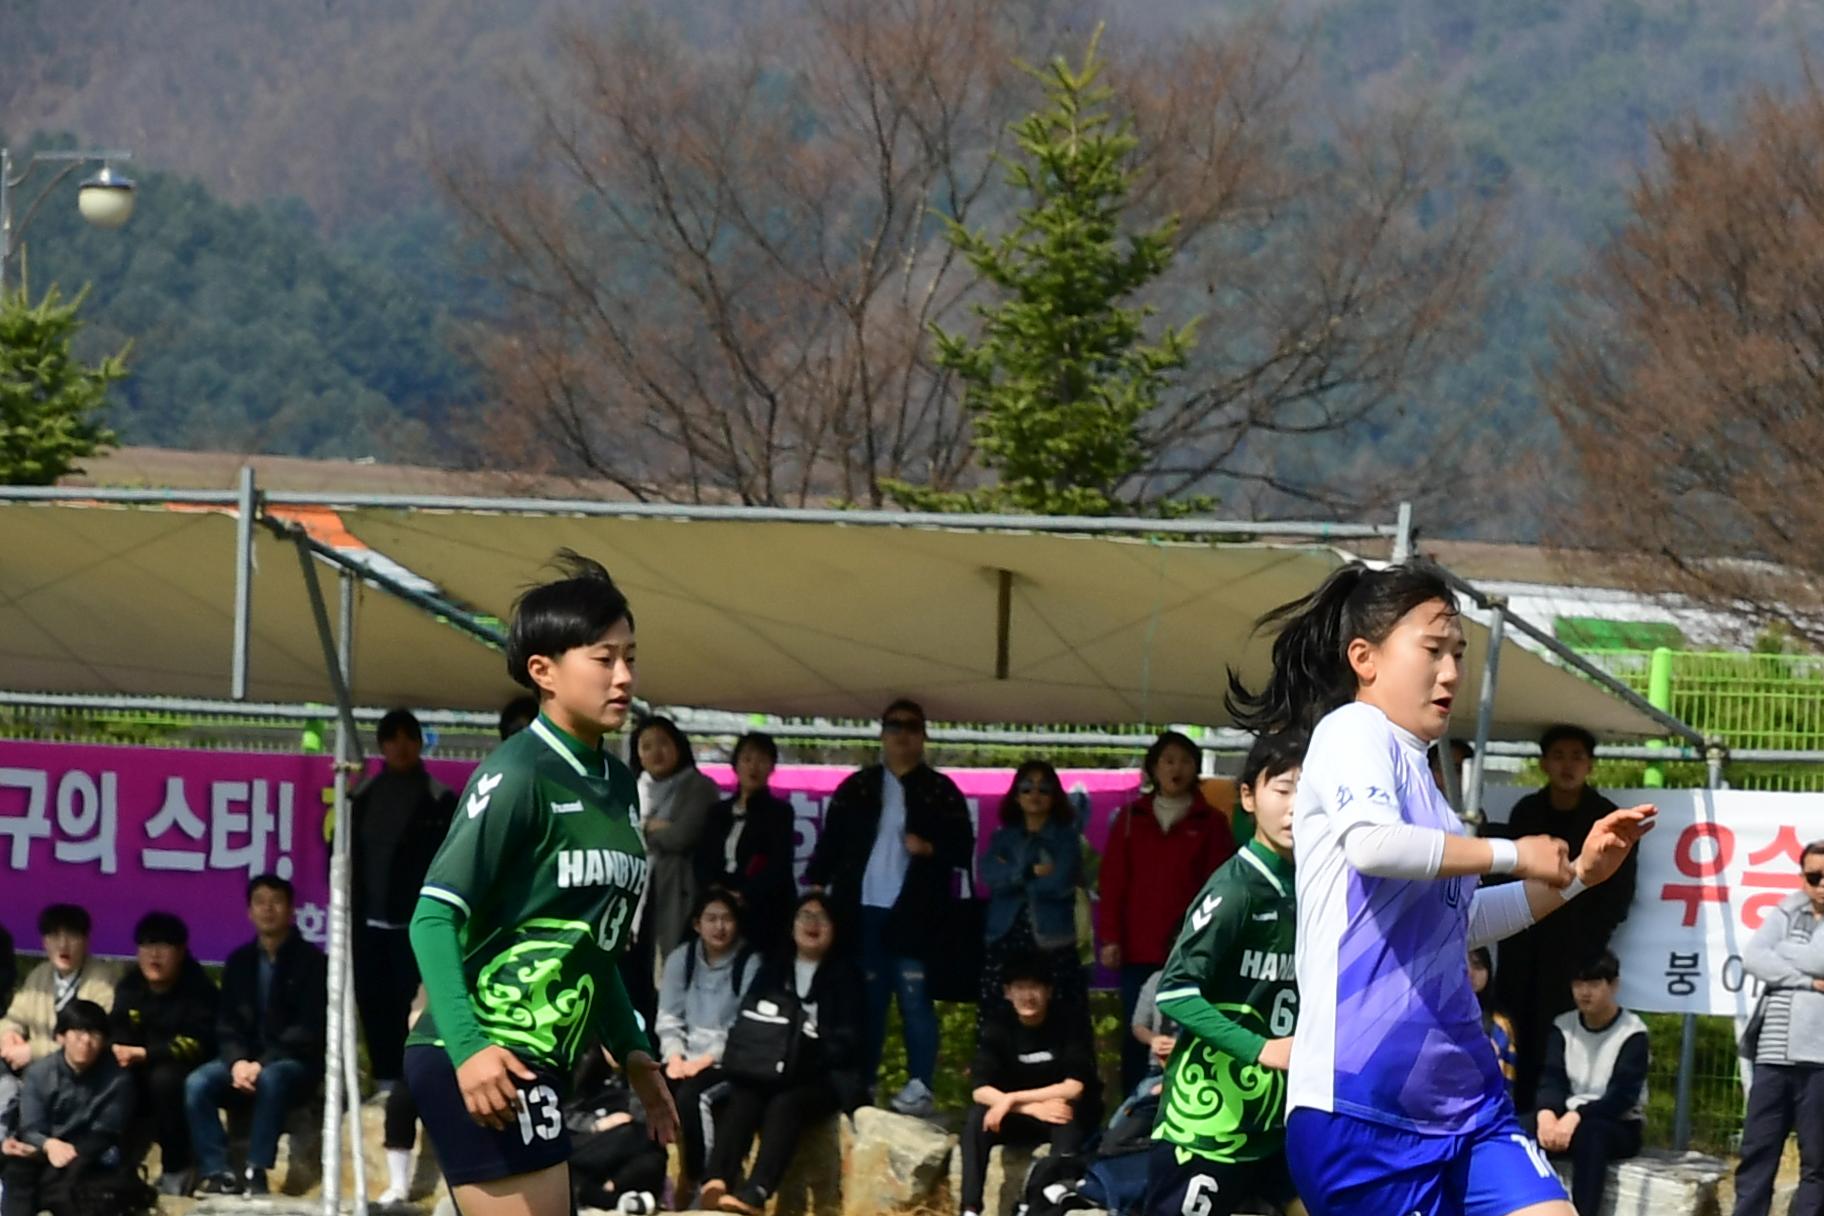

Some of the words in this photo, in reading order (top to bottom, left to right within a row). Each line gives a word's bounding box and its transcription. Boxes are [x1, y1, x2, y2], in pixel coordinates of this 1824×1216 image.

[142, 776, 295, 881] 스타!
[1269, 988, 1297, 1037] 6
[516, 1084, 562, 1146] 13
